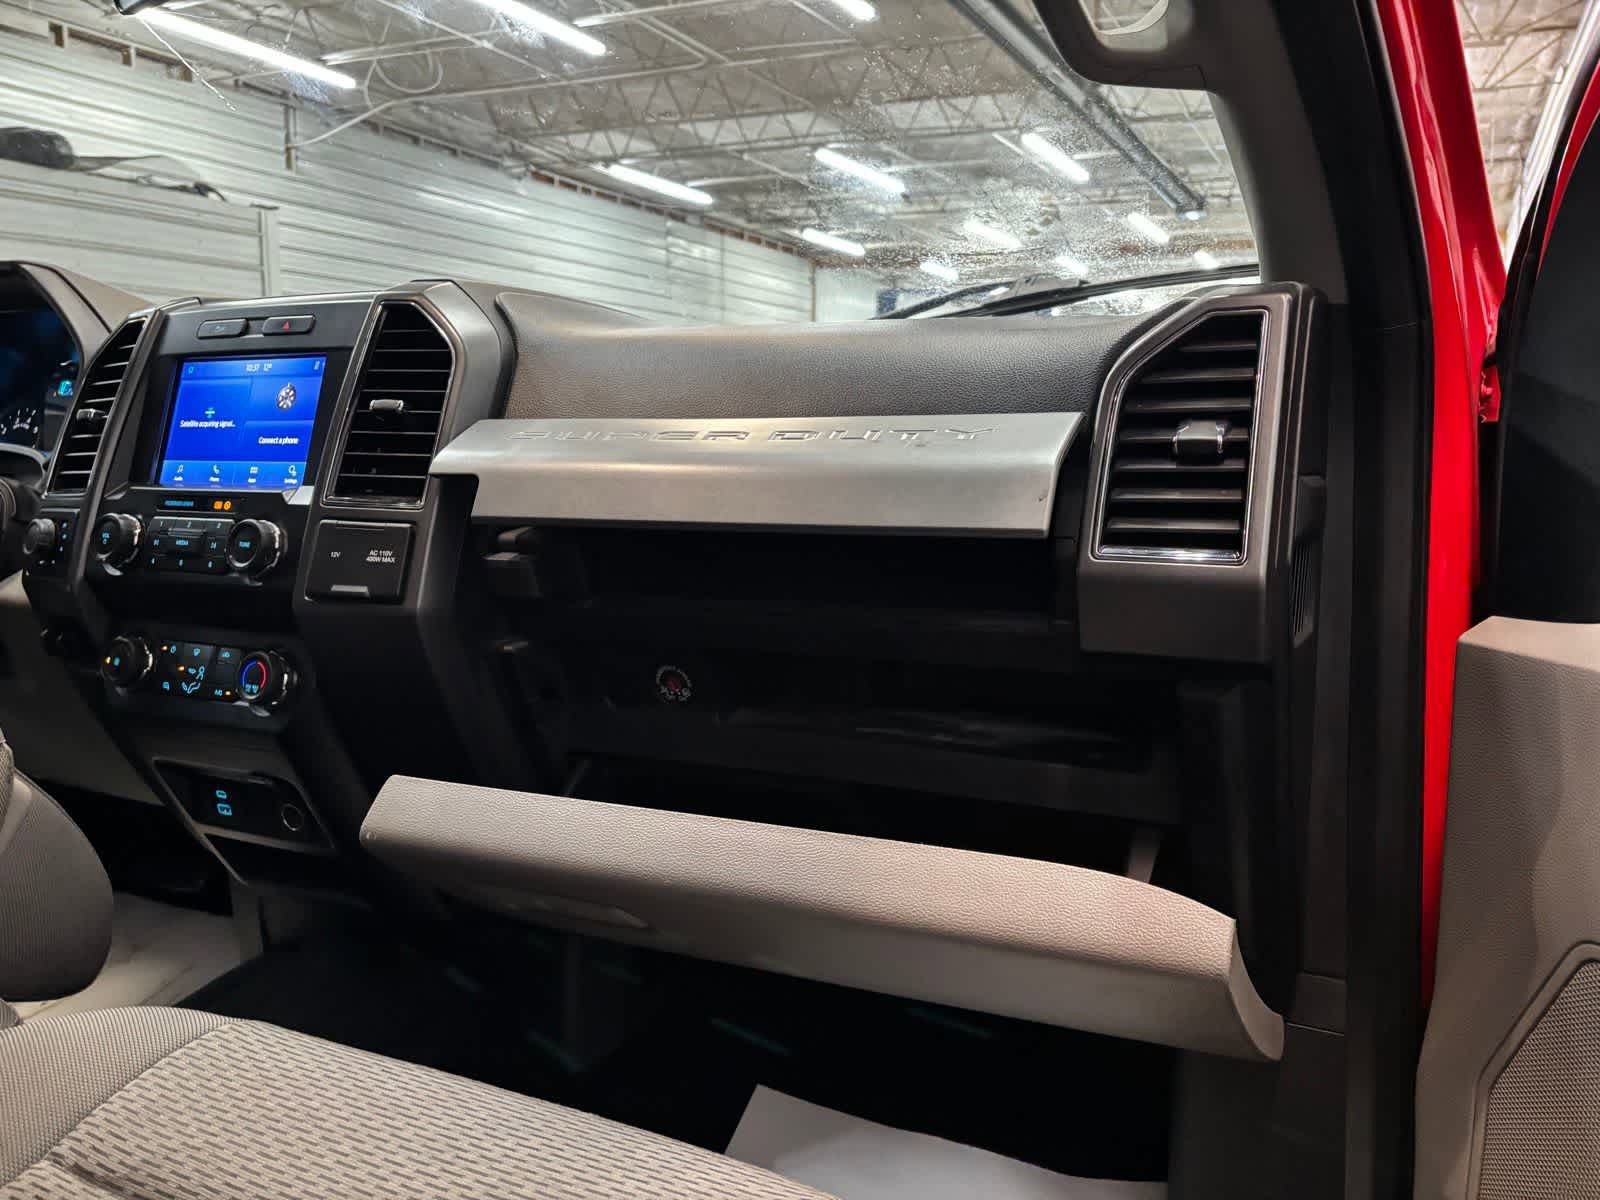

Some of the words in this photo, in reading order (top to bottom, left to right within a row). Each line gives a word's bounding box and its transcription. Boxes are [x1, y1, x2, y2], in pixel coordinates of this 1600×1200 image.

[504, 430, 751, 442] SUPER
[768, 427, 1000, 442] DUTY
[258, 436, 279, 444] Connect
[282, 436, 299, 446] phone
